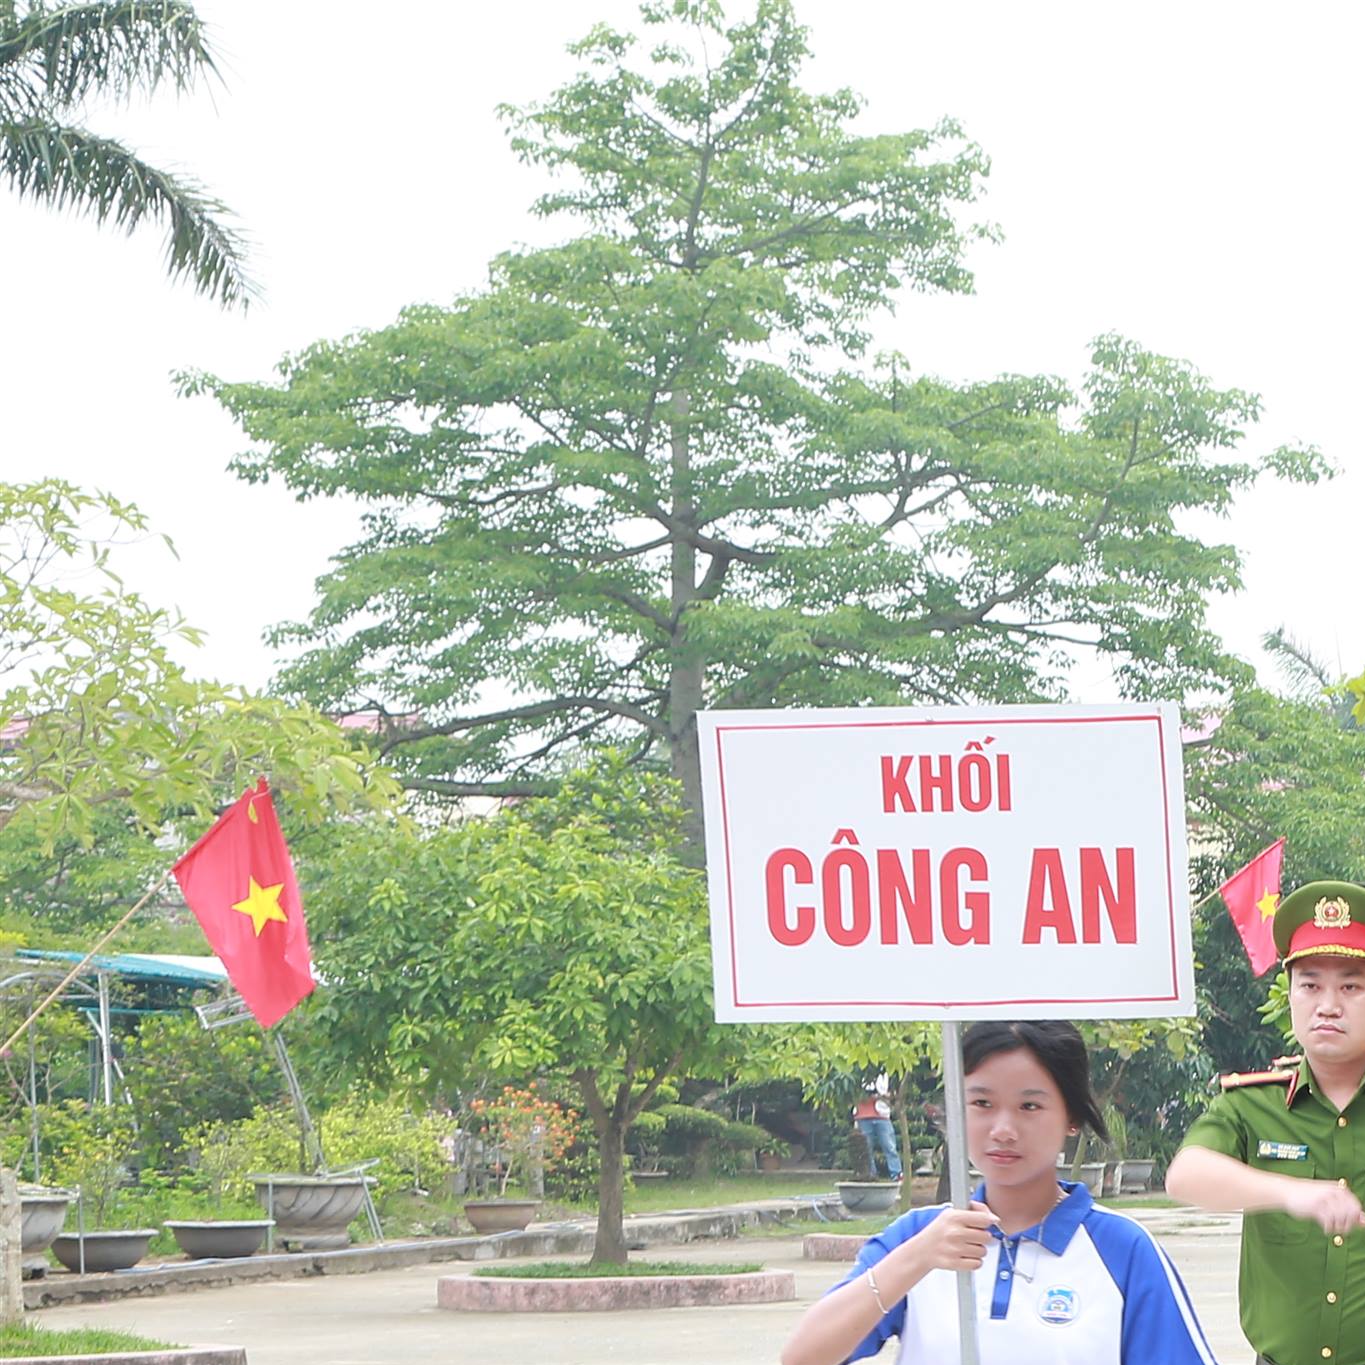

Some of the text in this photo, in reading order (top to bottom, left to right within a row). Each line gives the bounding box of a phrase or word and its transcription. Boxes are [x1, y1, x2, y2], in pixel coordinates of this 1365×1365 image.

[880, 736, 1012, 813] KHỐI
[765, 828, 1138, 947] CÔNG AN
